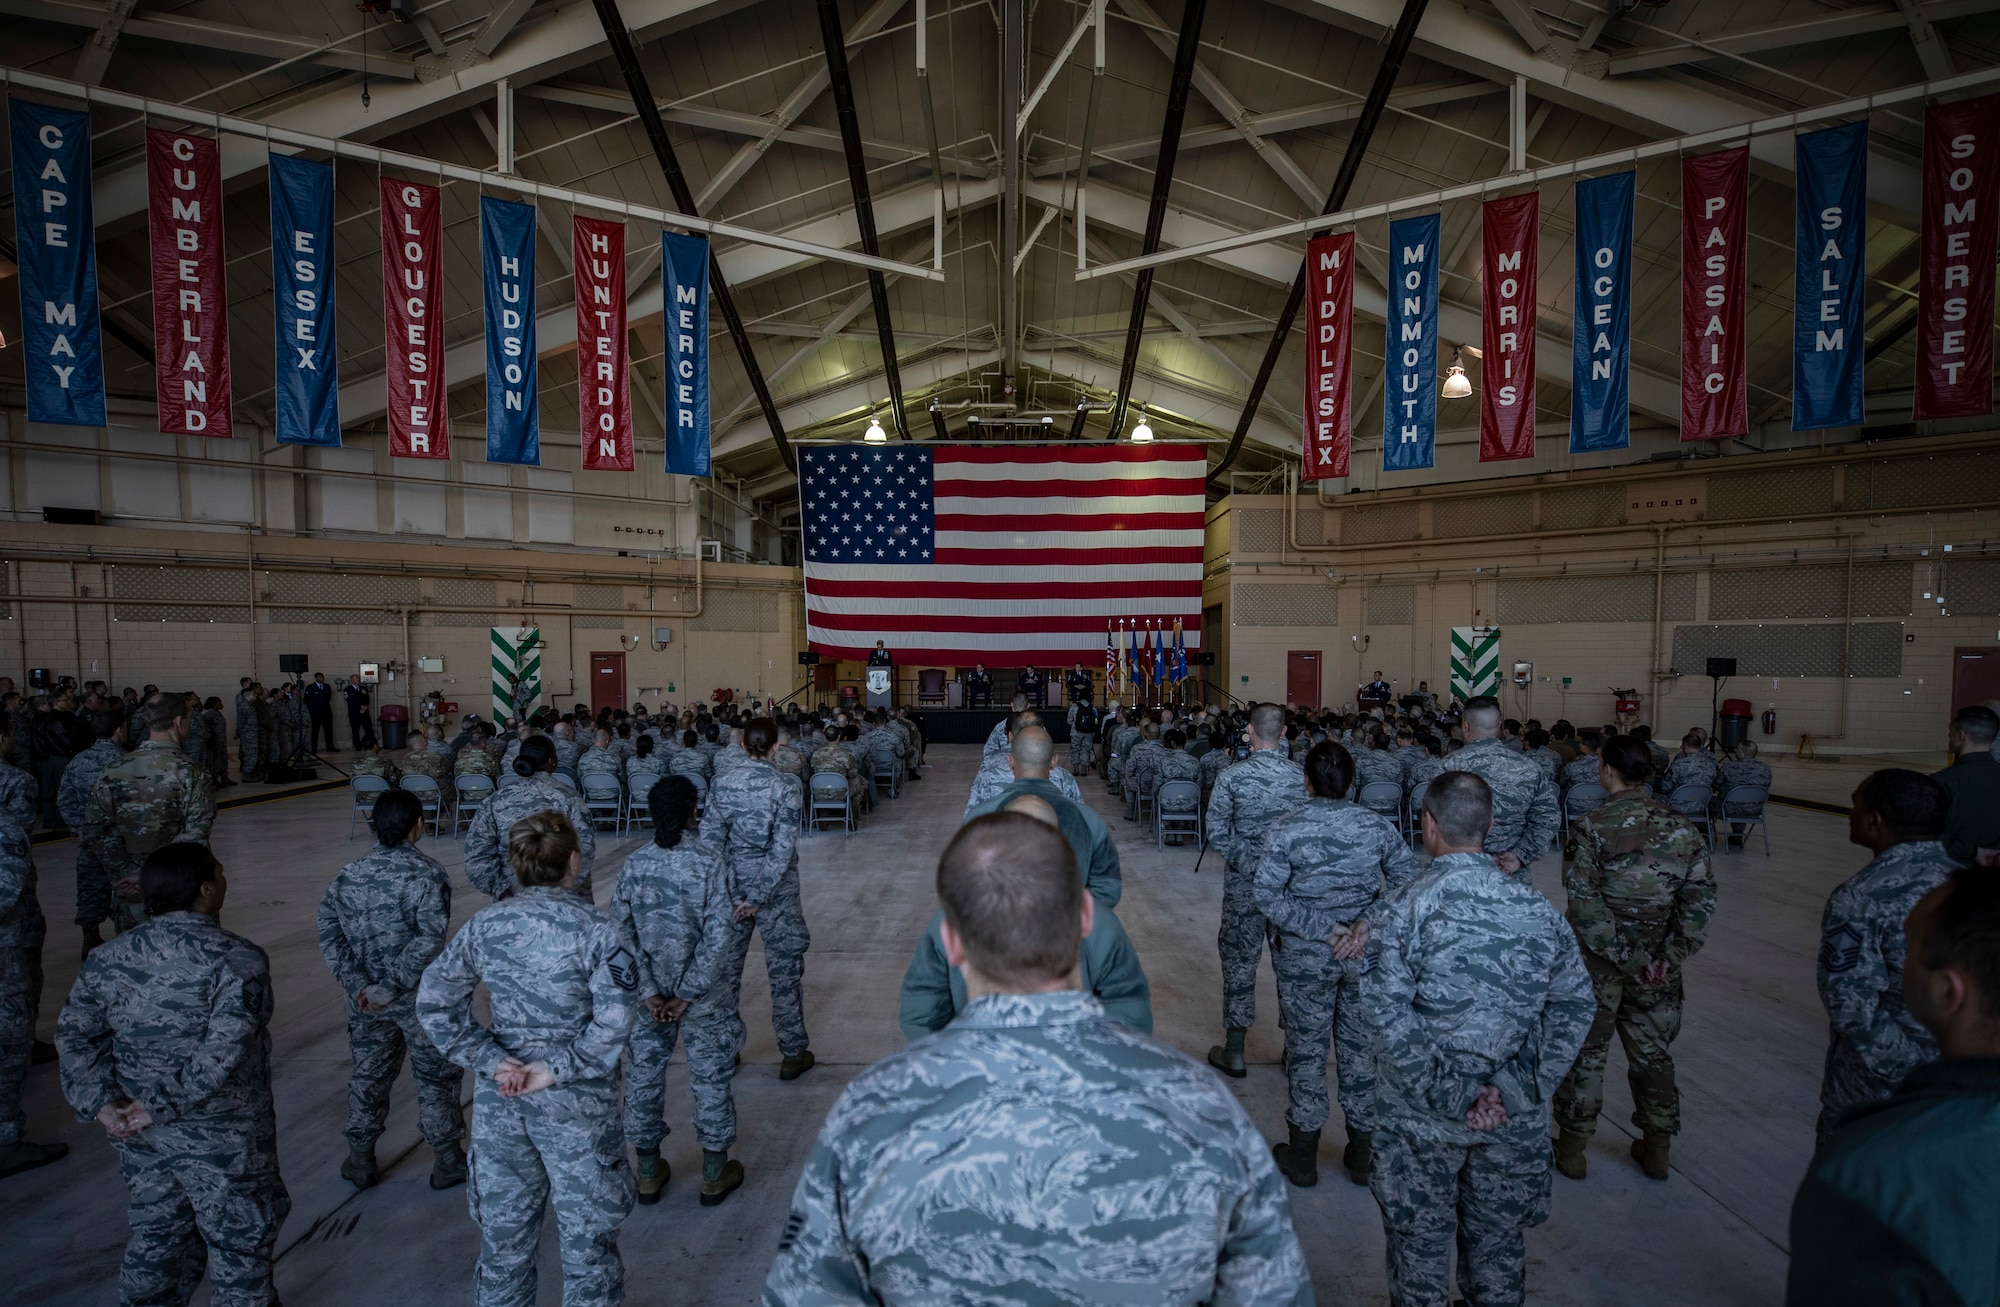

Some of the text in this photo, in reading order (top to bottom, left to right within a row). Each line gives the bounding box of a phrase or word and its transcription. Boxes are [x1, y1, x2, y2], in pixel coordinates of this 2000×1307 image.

[39, 125, 77, 389] CAPE MAY
[172, 138, 207, 431] CUMBERLAND
[295, 230, 317, 371] ESSEX
[402, 186, 430, 453] GLOUCESTER
[501, 255, 522, 411] HUDSON
[591, 233, 616, 458] HUNTERDON
[676, 284, 696, 428] MERCER
[1401, 243, 1425, 444] MONMOUTH
[1498, 250, 1521, 407] MORRIS
[1592, 247, 1614, 381] OCEAN
[1703, 196, 1726, 394] PASSAIC
[1815, 206, 1844, 352] SALEM
[1940, 134, 1976, 385] SOMERSET
[1318, 249, 1340, 466] MIDDLESEX
